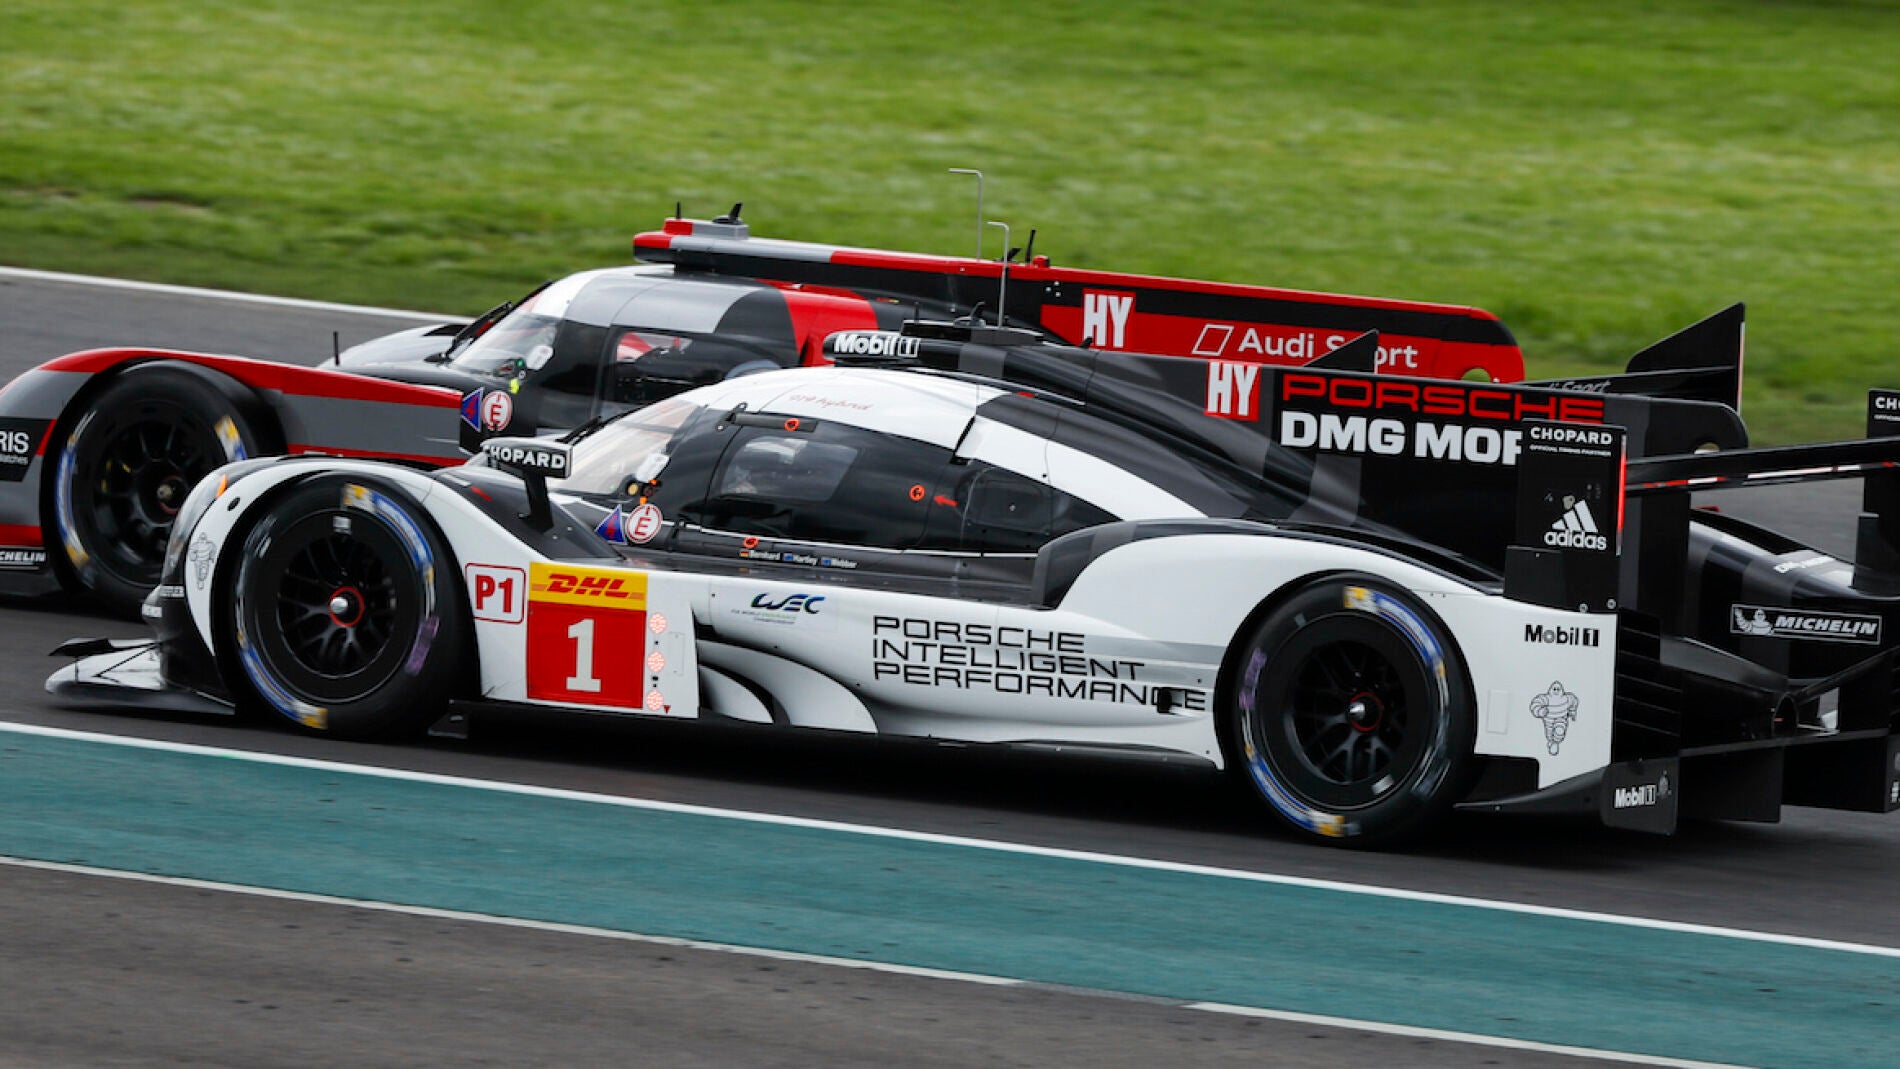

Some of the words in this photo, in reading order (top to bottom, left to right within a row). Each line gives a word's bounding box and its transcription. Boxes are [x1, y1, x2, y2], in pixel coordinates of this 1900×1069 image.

[1083, 294, 1133, 348] HY
[834, 333, 897, 355] Mobil
[1238, 328, 1314, 358] Audi
[1326, 336, 1418, 368] Sort
[1207, 361, 1258, 416] HY
[1283, 374, 1604, 424] PORSCHE
[1875, 397, 1900, 409] CH
[0, 431, 29, 454] RIS
[1280, 410, 1405, 455] DMG
[1530, 427, 1612, 445] CHOPARD
[1544, 529, 1607, 551] adidas
[475, 574, 513, 613] P1
[546, 574, 631, 599] DHL
[751, 593, 825, 614] WEC
[873, 615, 1085, 654] PORSCHE
[1524, 624, 1579, 646] Mobil
[1582, 628, 1599, 647] 1
[1775, 615, 1878, 635] MICHELIN
[566, 618, 601, 693] 1
[873, 638, 1145, 681] INTELLIGENT
[874, 661, 1206, 711] PERFORMANCE
[1614, 786, 1644, 808] Mobil
